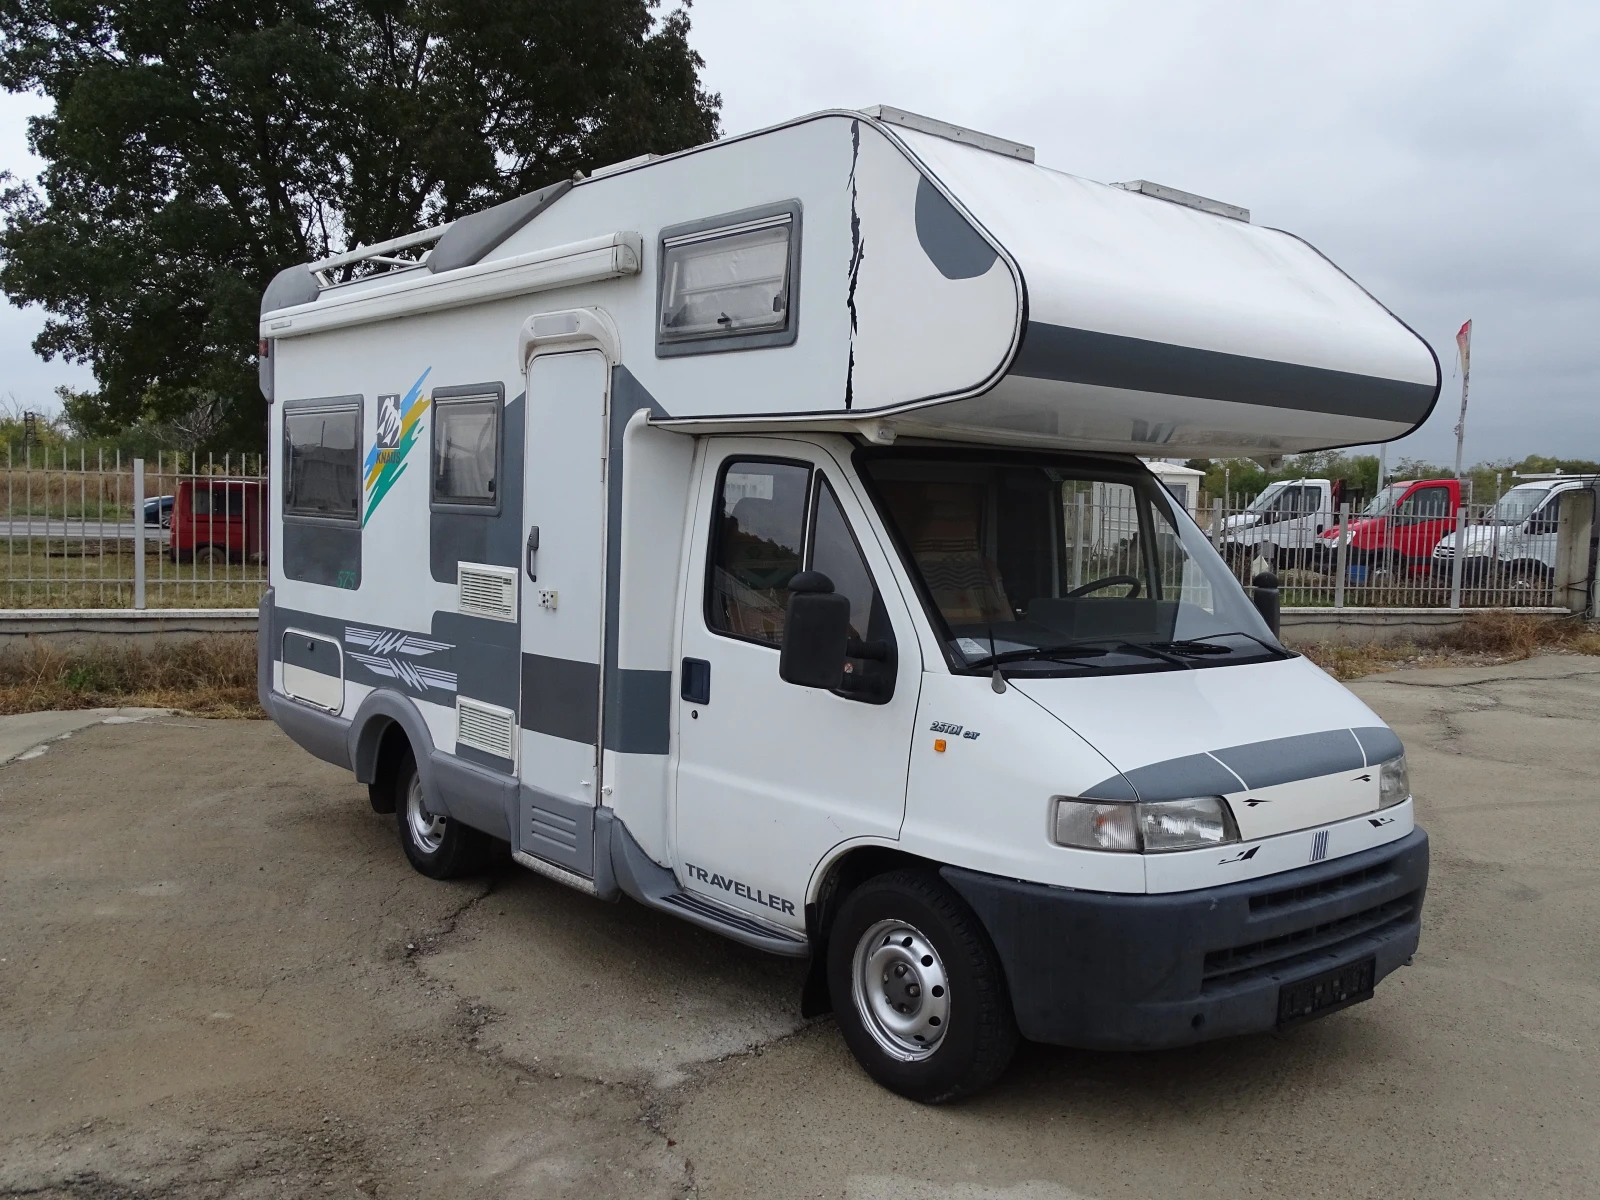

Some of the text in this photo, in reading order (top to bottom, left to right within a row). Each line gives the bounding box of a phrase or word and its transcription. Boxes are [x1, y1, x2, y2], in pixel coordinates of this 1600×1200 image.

[376, 451, 401, 464] KNAUS
[337, 570, 356, 589] 575
[685, 862, 795, 916] TRAVELLER
